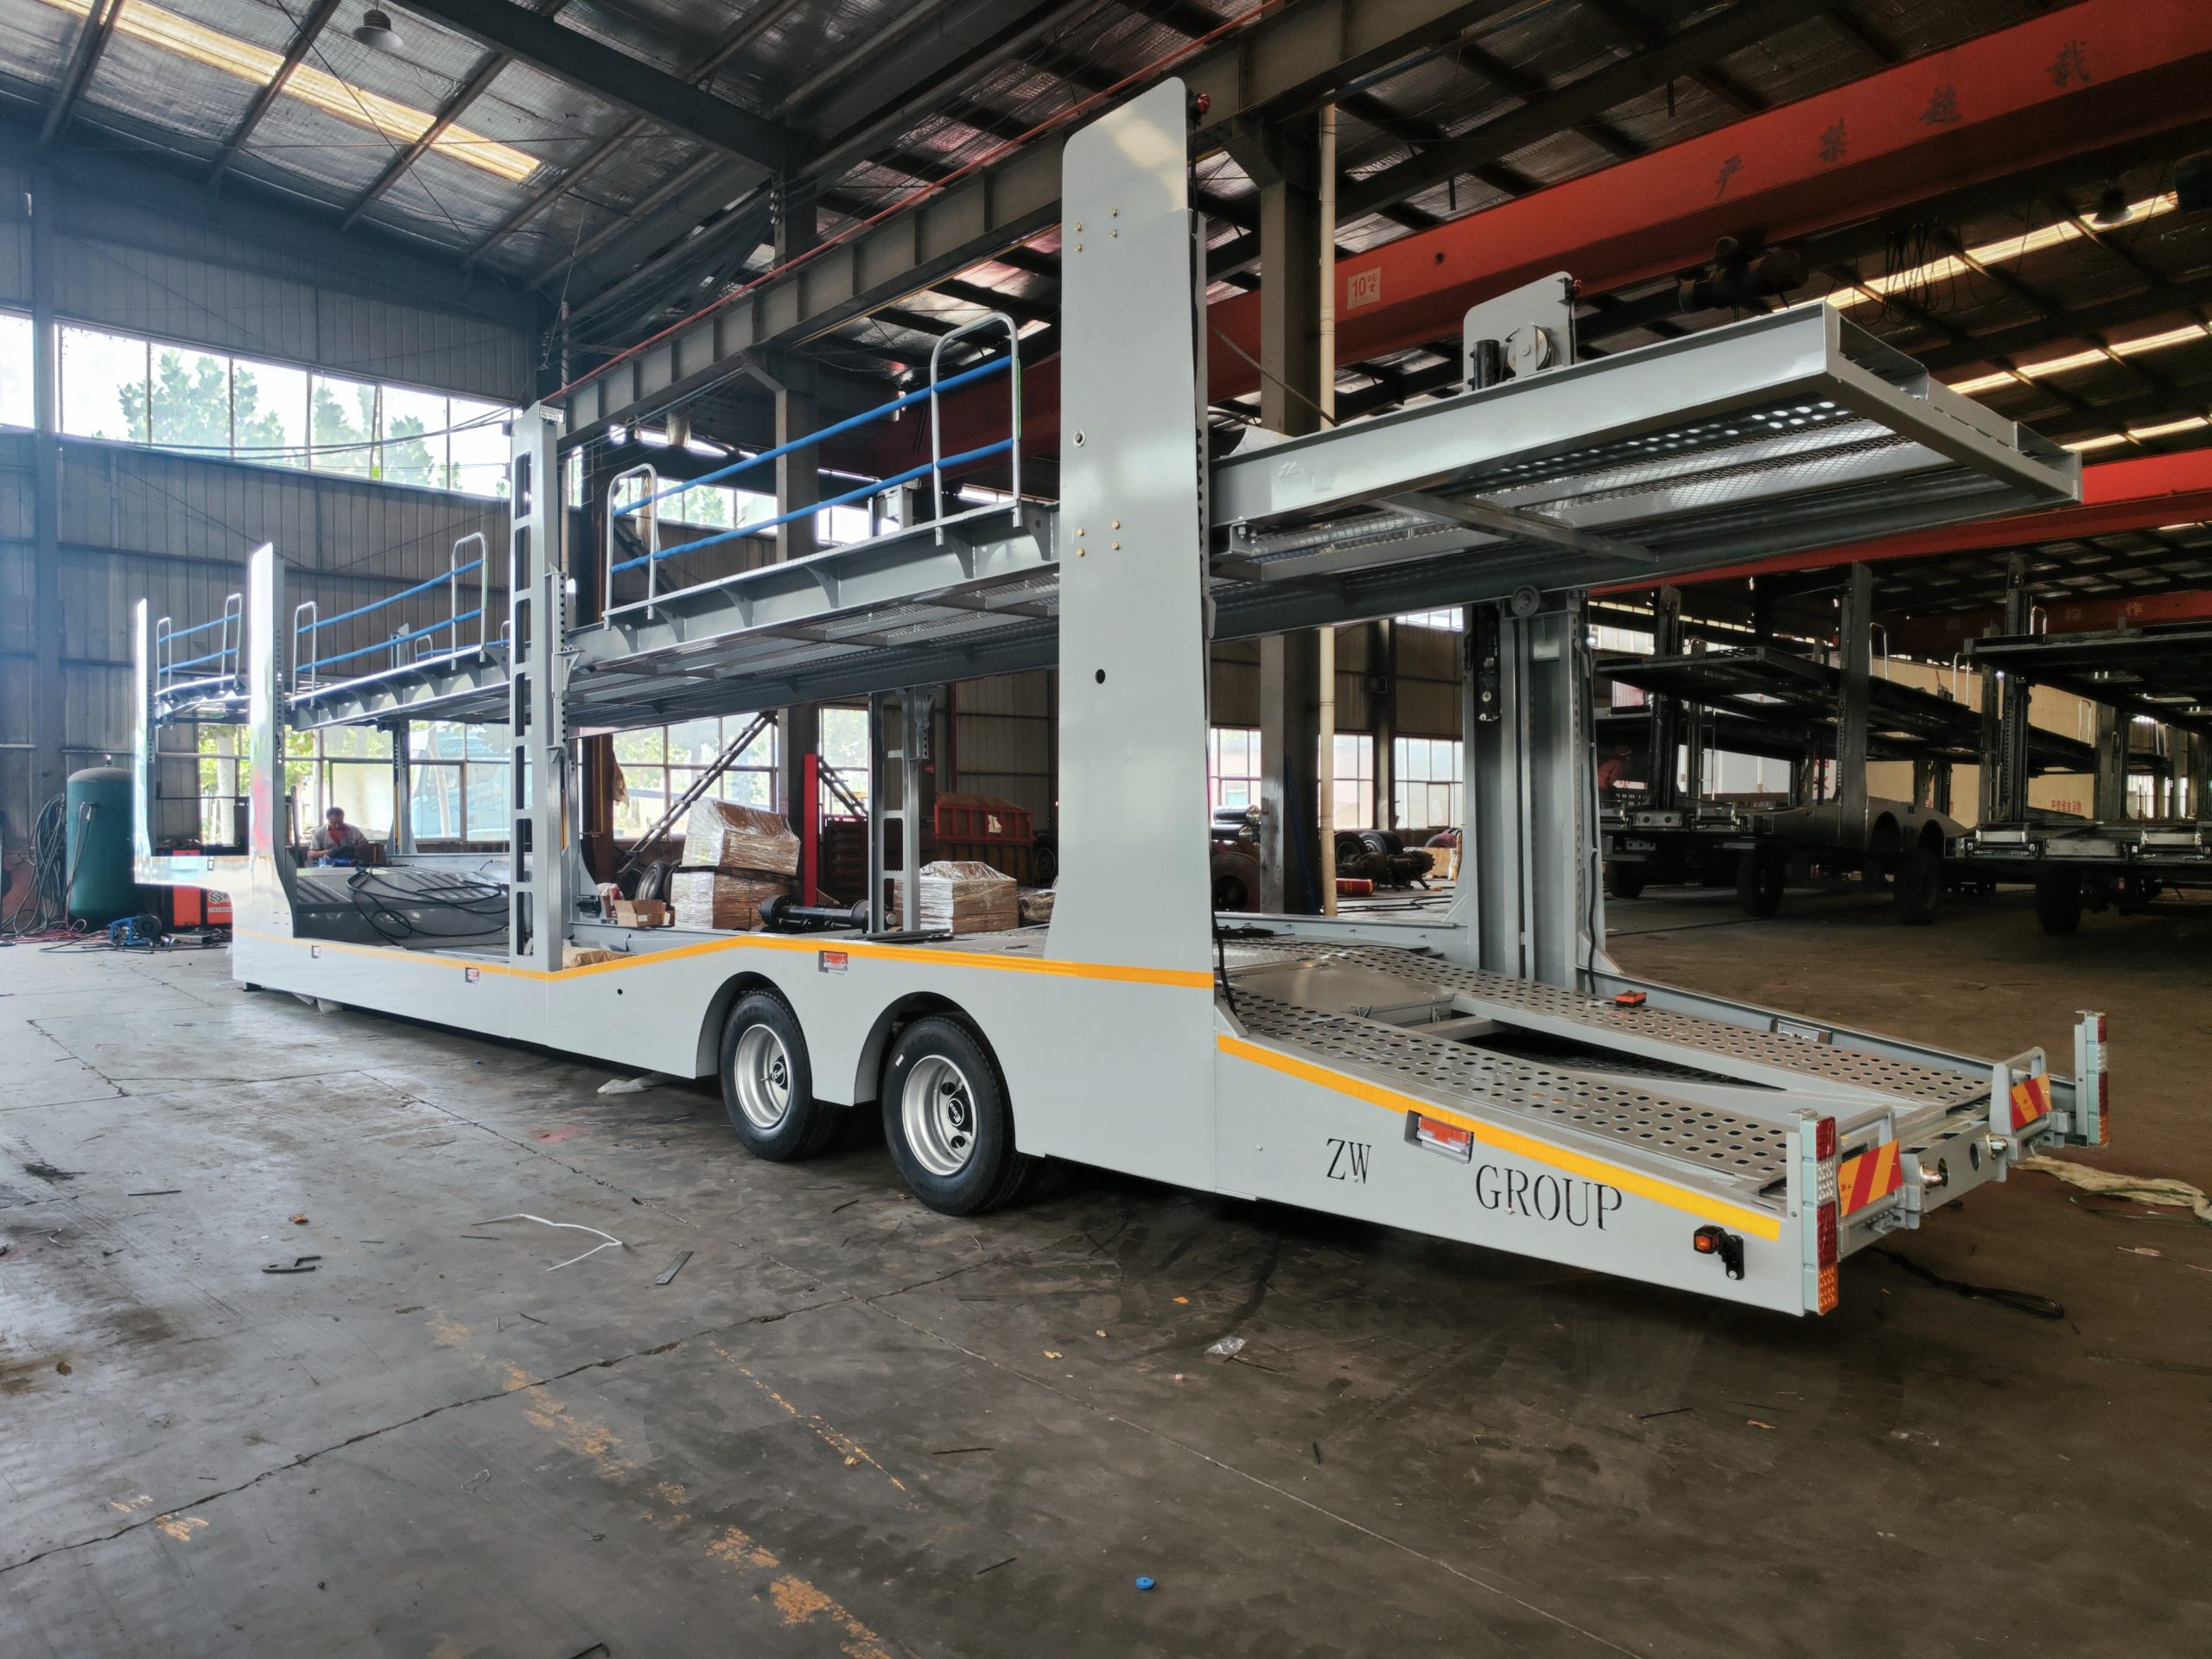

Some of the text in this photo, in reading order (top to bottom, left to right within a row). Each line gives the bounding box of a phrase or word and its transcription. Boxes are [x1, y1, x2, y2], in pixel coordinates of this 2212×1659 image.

[1352, 276, 1367, 298] 10
[1326, 1138, 1623, 1230] ZW GROUP
